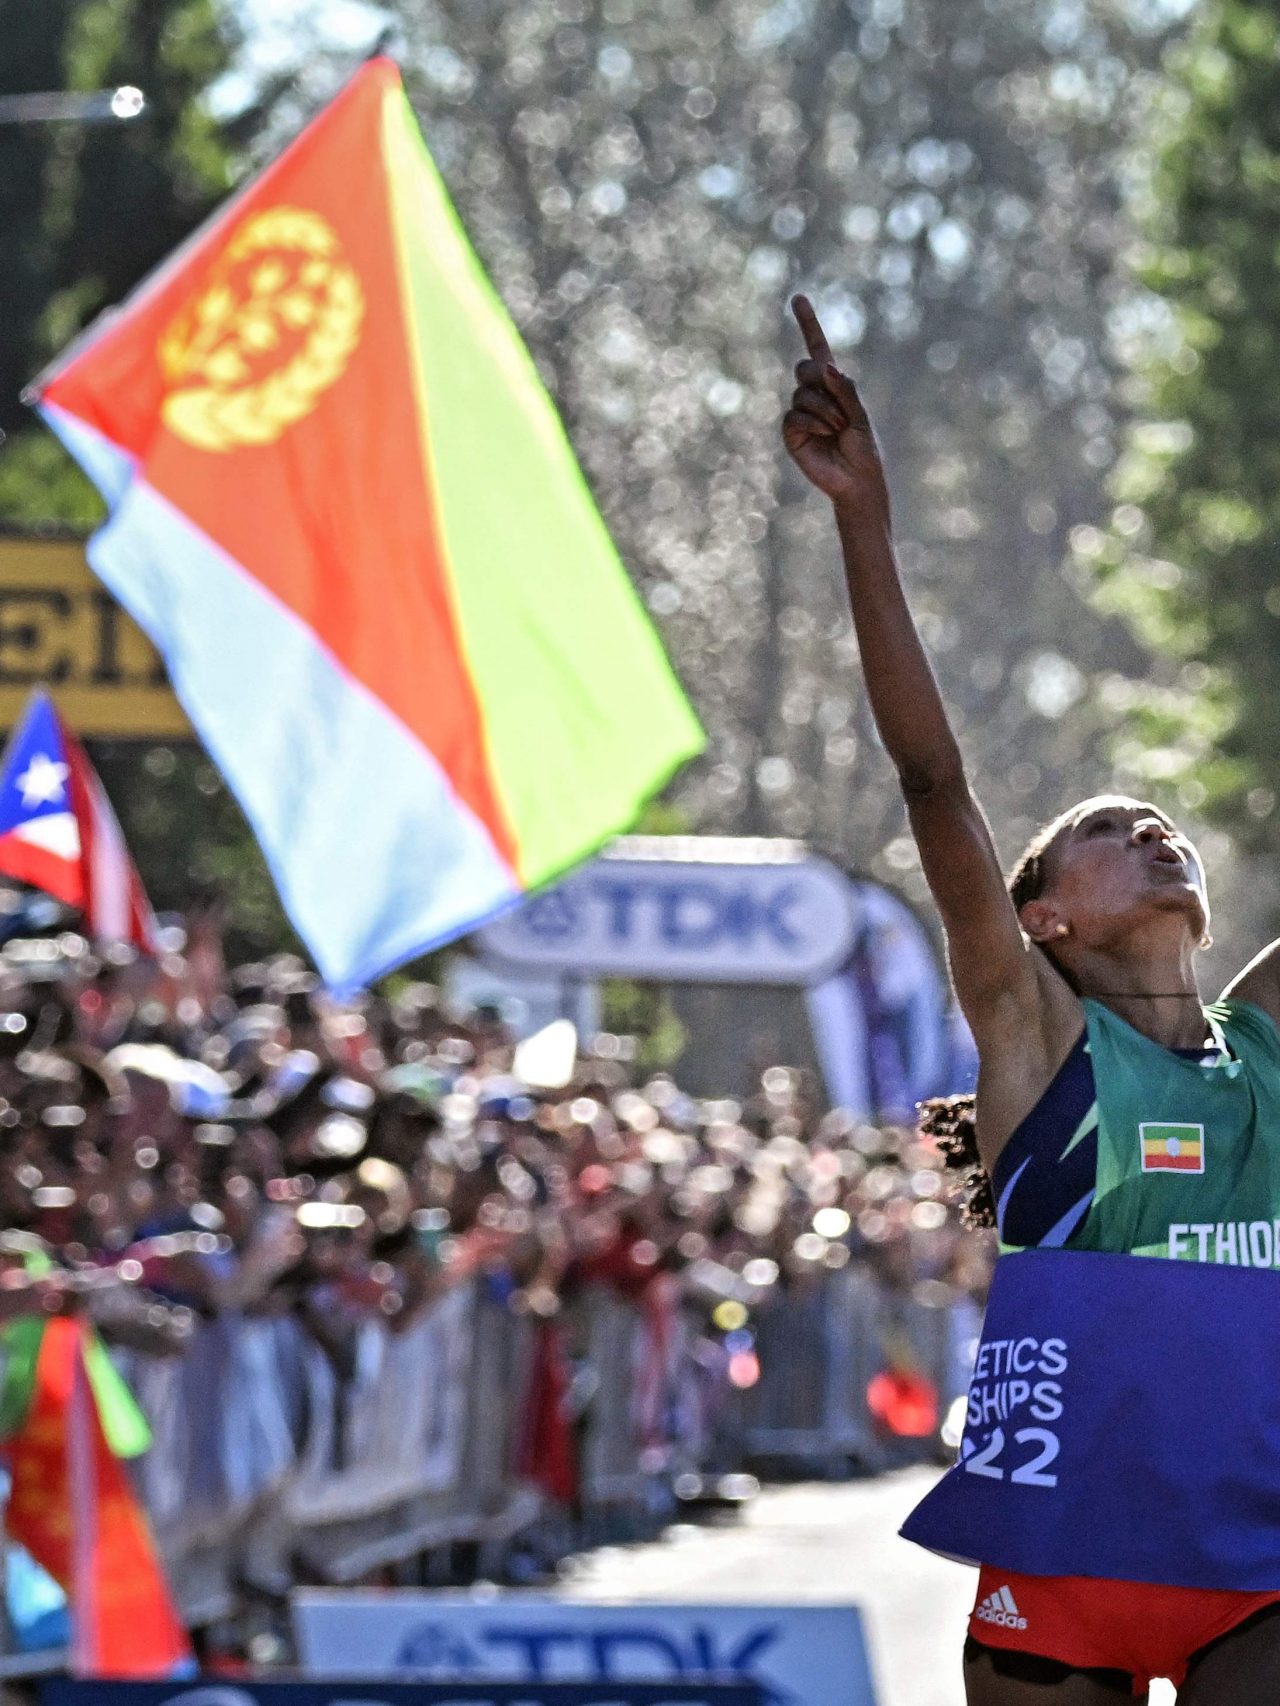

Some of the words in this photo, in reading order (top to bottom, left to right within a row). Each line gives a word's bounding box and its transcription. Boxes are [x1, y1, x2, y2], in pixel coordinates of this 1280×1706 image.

[594, 876, 804, 953] TDK
[972, 1337, 1069, 1380] ETICS
[976, 1606, 1028, 1631] adidas
